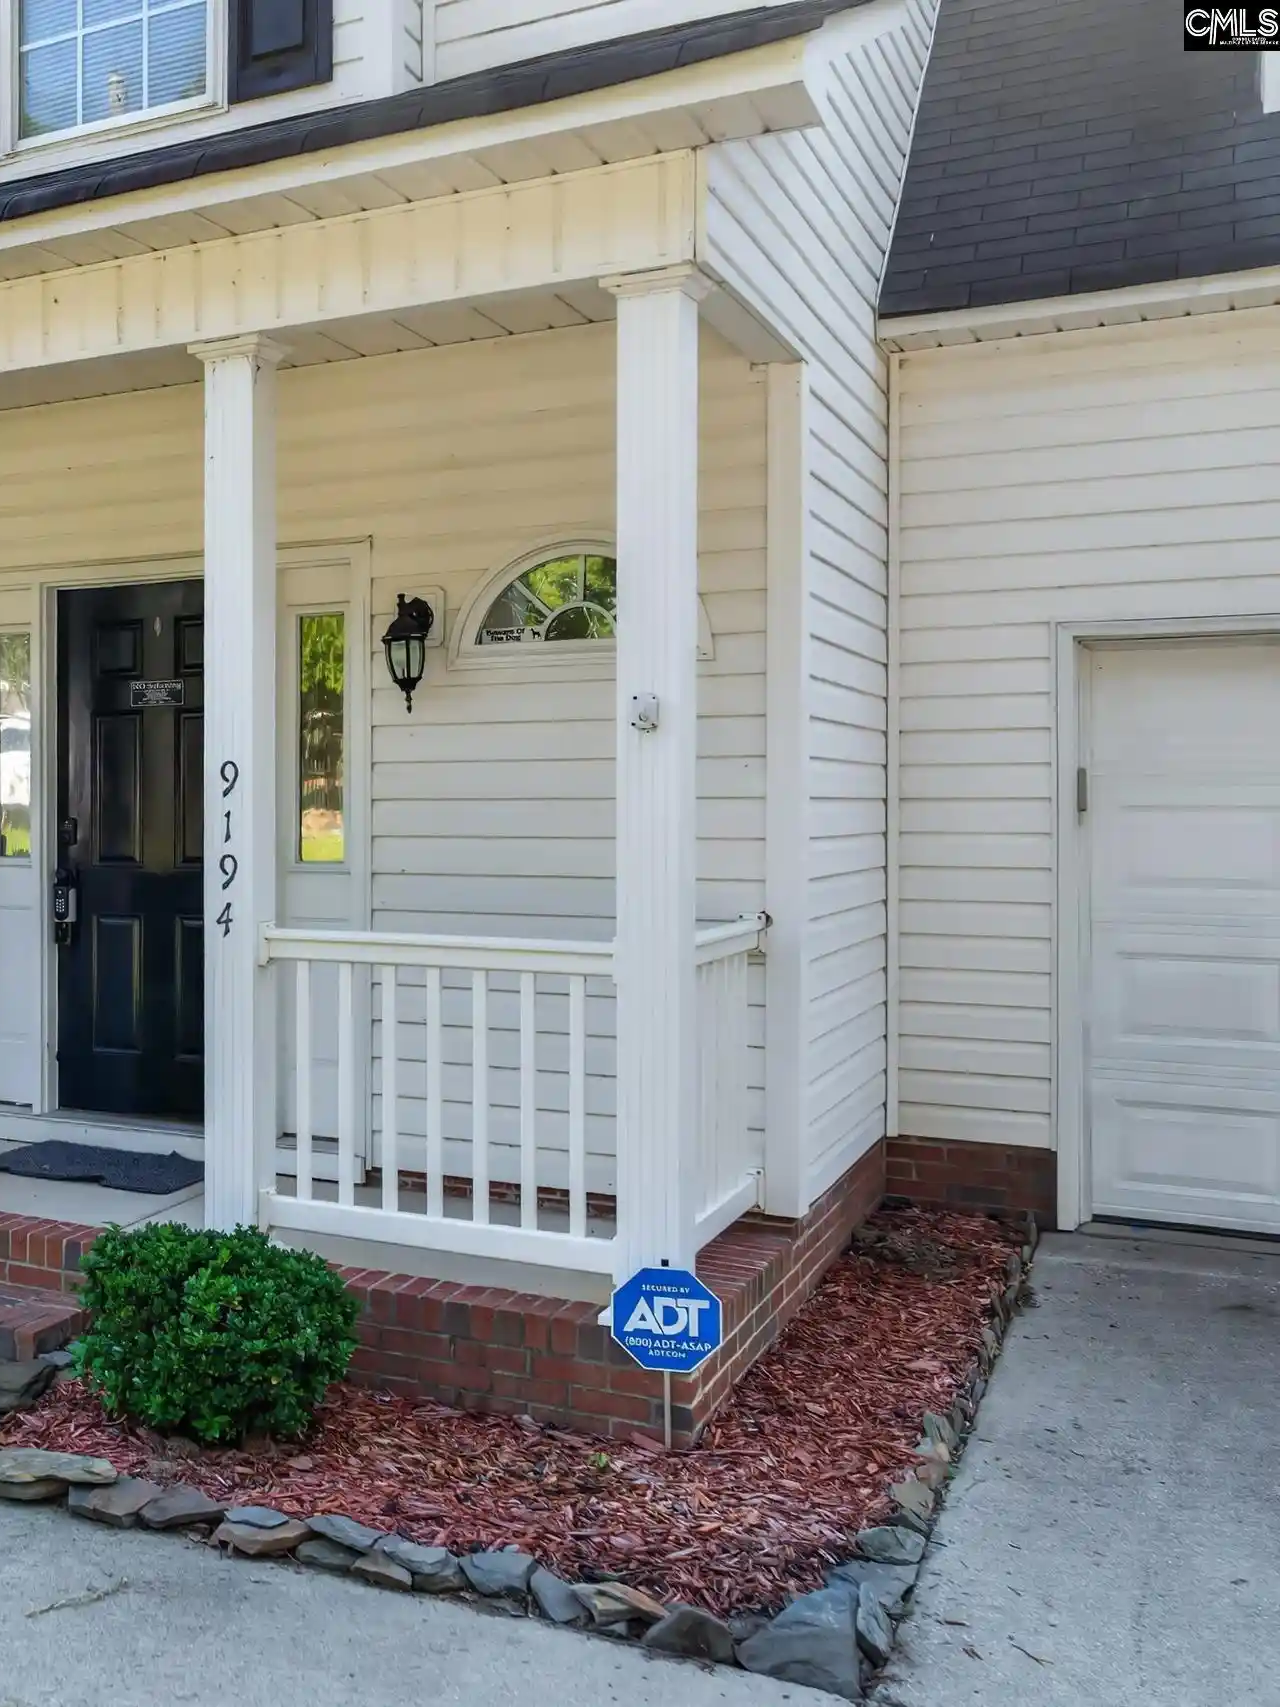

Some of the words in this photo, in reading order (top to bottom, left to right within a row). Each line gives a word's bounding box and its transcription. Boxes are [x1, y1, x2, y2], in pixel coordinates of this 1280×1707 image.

[215, 760, 239, 938] 9194
[641, 1284, 678, 1293] SECURED
[680, 1286, 690, 1294] BY
[623, 1296, 710, 1337] ADT
